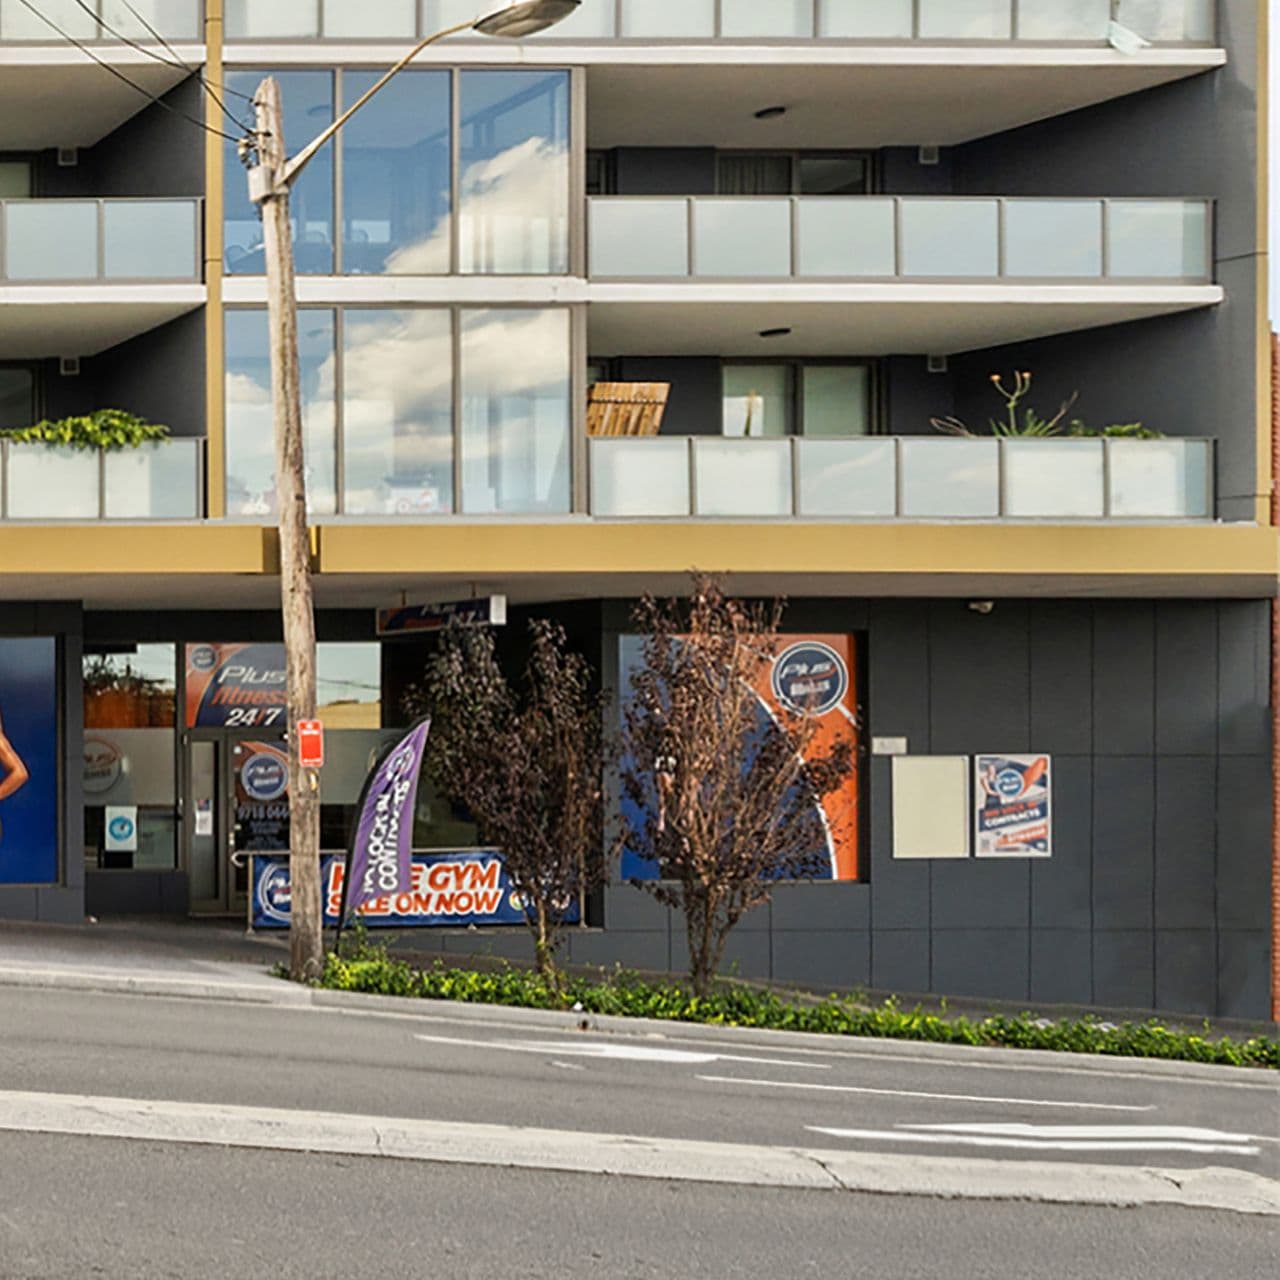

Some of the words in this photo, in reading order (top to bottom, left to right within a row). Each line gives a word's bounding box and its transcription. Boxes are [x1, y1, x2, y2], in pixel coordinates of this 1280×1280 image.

[217, 665, 287, 684] Plus
[224, 707, 283, 727] 24/7
[428, 861, 498, 891] GYM
[395, 893, 433, 914] ON
[434, 891, 501, 913] NOW
